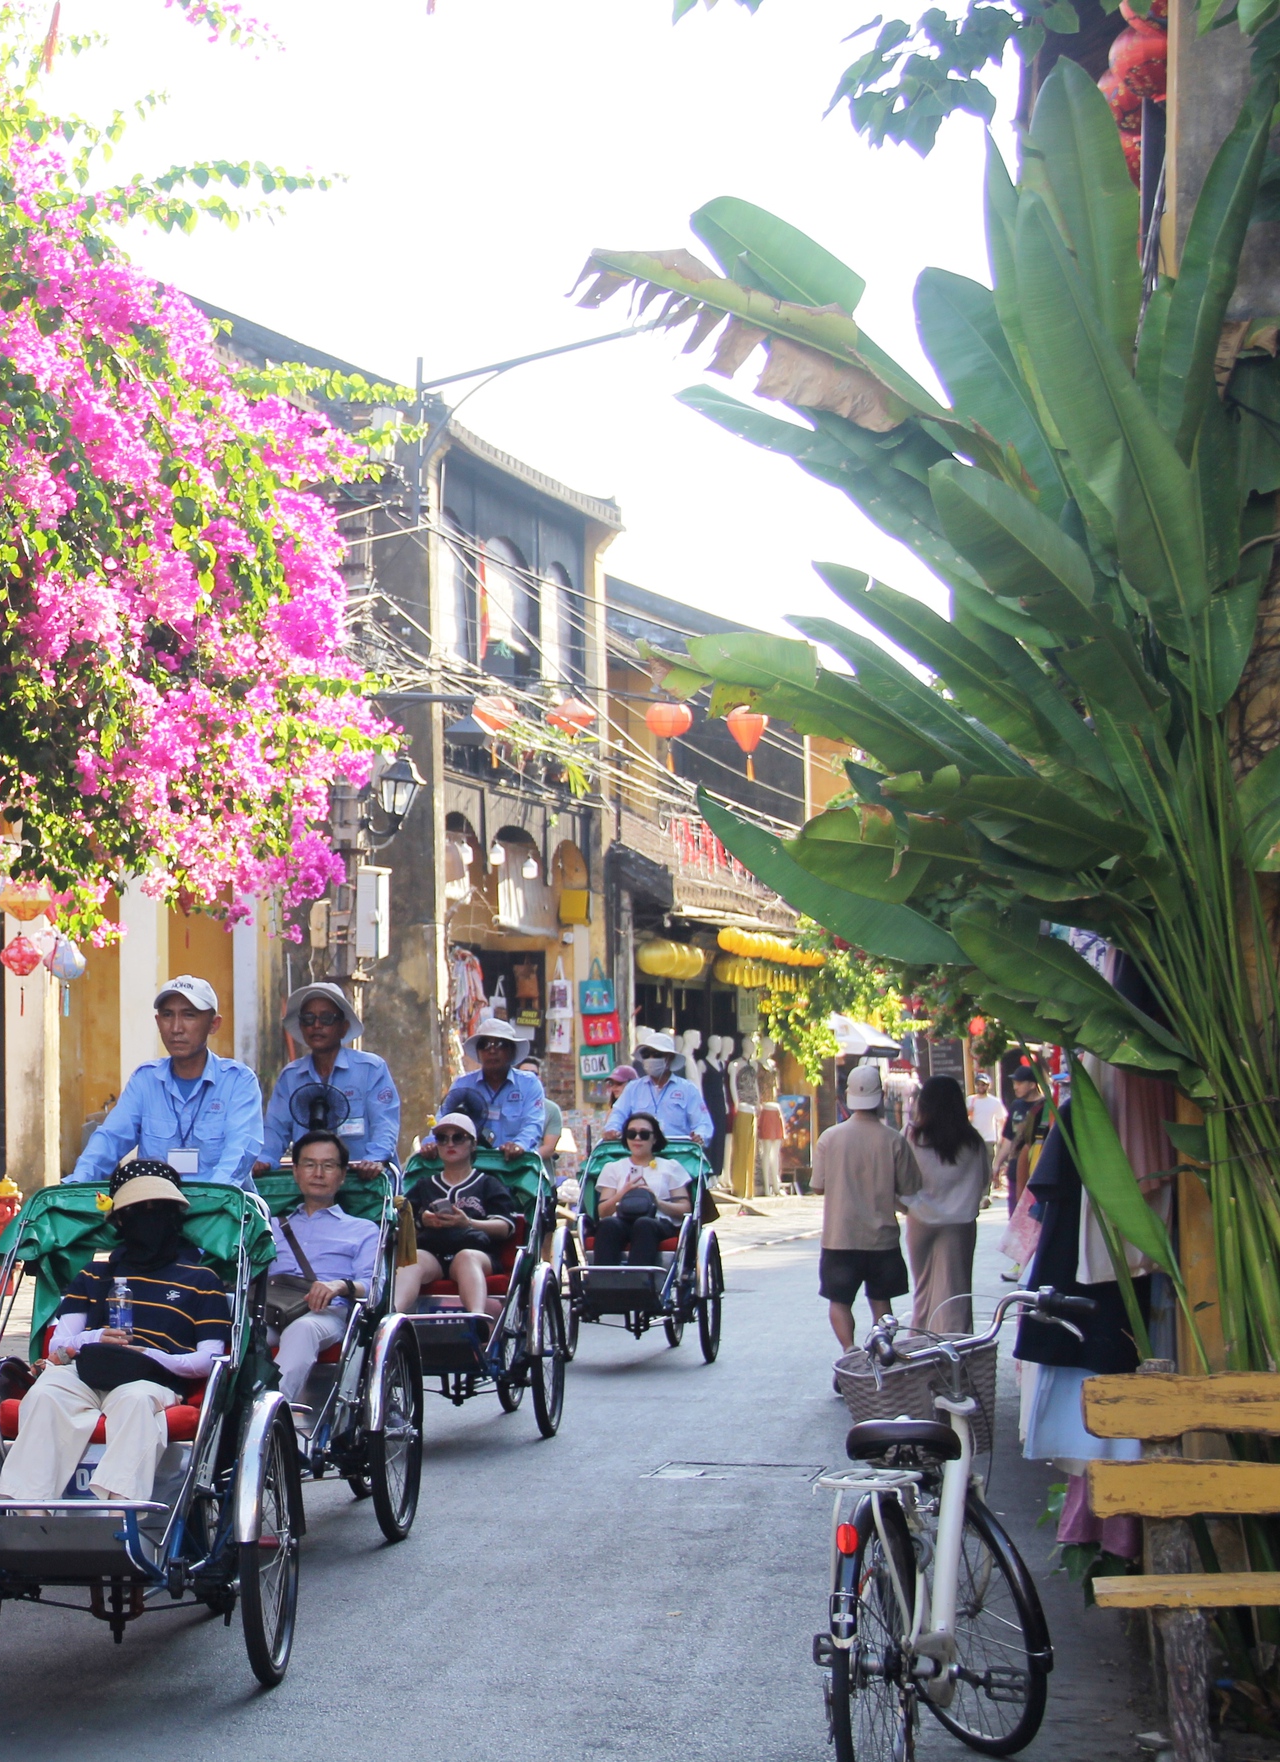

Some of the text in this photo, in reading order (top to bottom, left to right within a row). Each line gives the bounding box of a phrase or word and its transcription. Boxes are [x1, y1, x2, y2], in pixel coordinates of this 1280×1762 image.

[521, 1010, 538, 1019] MONEY
[516, 1017, 540, 1027] EXCHANGE
[583, 1055, 607, 1074] 60K
